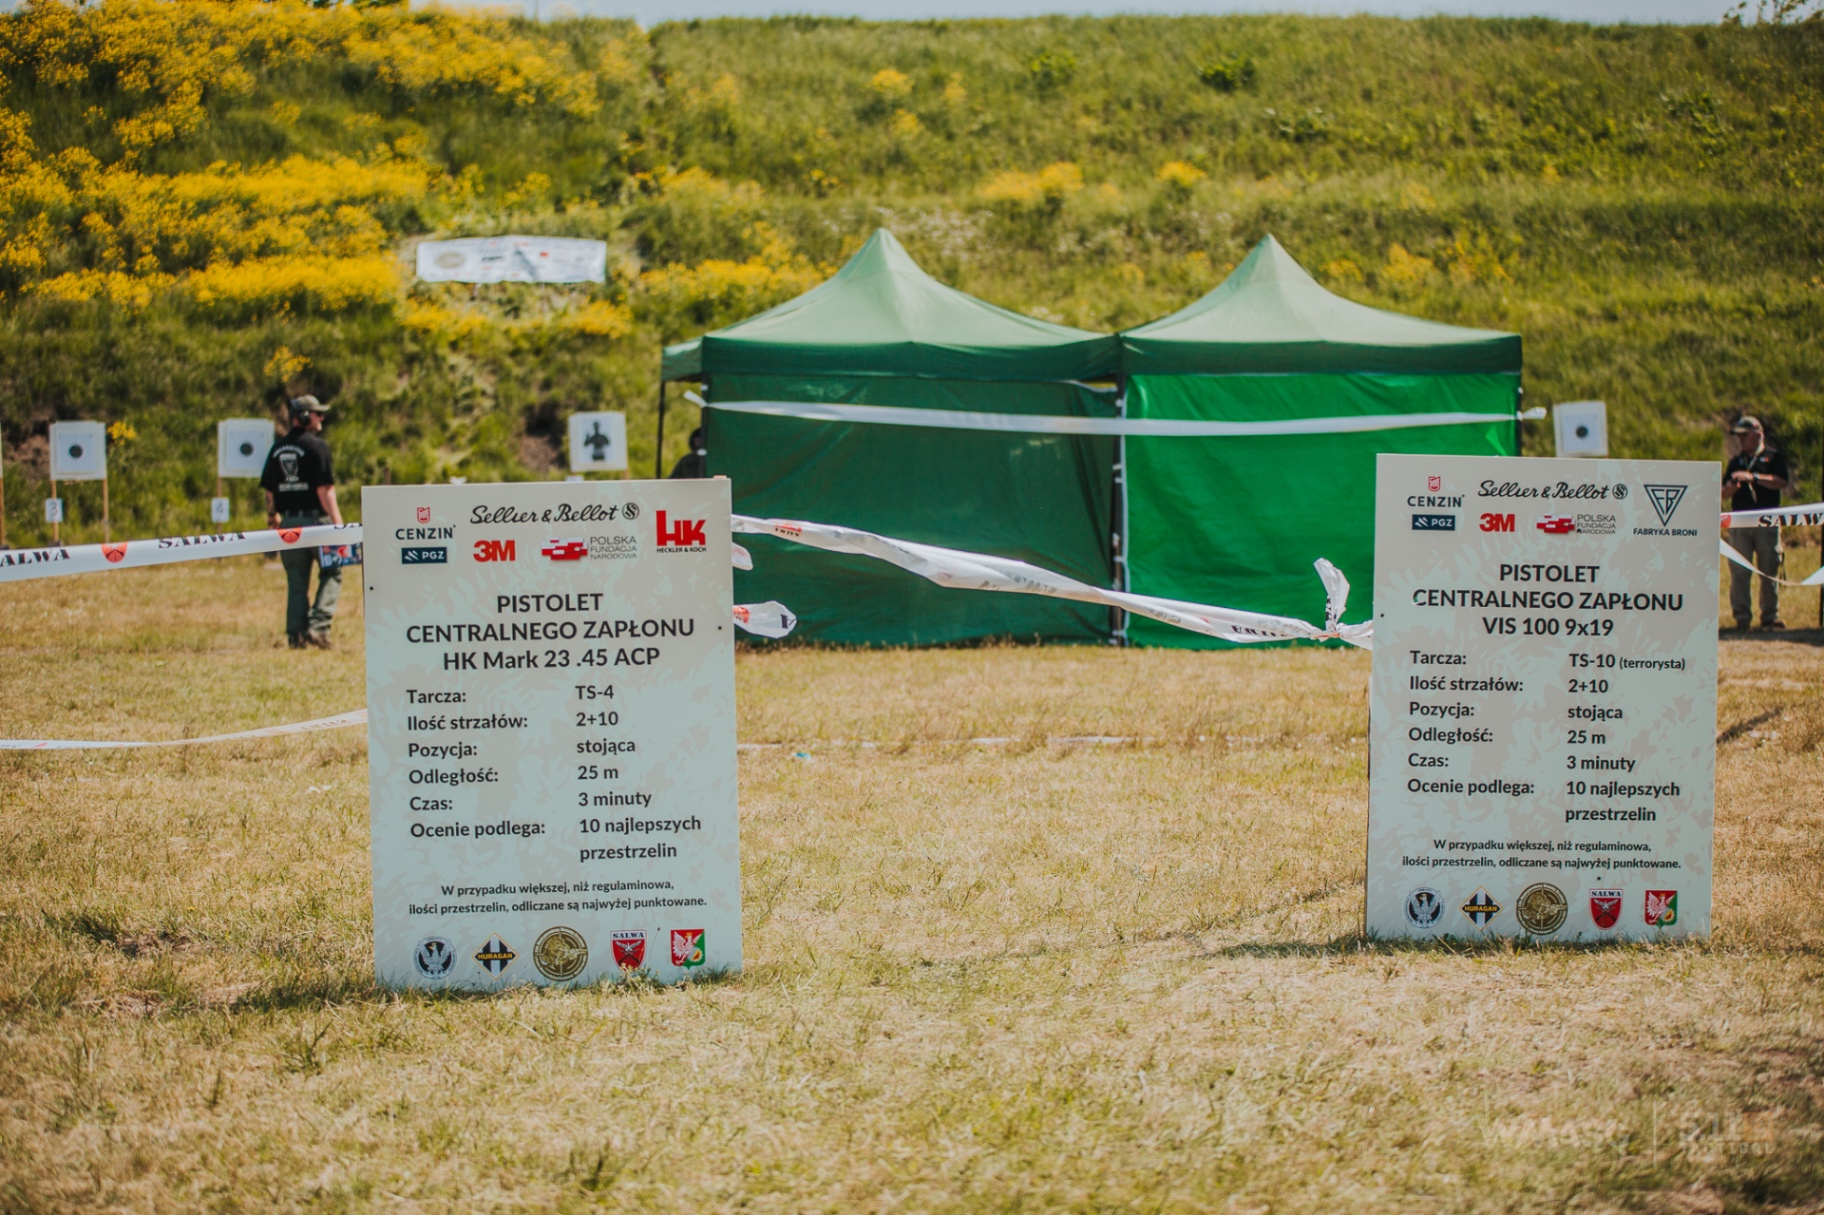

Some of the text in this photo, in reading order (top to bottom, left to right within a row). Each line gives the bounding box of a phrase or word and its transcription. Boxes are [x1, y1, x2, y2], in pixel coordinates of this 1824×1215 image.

[1478, 480, 1538, 497] Sellier
[1541, 486, 1550, 498] &
[1552, 482, 1609, 499] Bellot
[470, 505, 537, 524] Sellier
[541, 507, 550, 523] &
[554, 504, 618, 521] Bellot
[656, 510, 706, 546] HK
[1432, 518, 1453, 527] PGZ
[1479, 513, 1515, 532] 3M
[590, 536, 637, 545] POLSKA
[1633, 528, 1697, 537] FABRYKA BRONI
[158, 533, 246, 549] SALWA
[422, 551, 444, 560] PGZ
[474, 540, 516, 562] 3M
[1500, 564, 1600, 582] PISTOLET
[498, 594, 603, 613] PISTOLET
[1413, 589, 1682, 611] CENTRALNEGO ZAPŁONU
[407, 619, 693, 643] CENTRALNEGO ZAPŁONU
[1483, 617, 1613, 636] VIS 100 9x19
[444, 648, 659, 670] HK Mark 23 .45 ACP
[1410, 651, 1466, 664] Tarcza:
[1569, 654, 1685, 670] TS-10 (terrorysta)
[1411, 676, 1523, 691] Ilość strzałów:
[1569, 679, 1608, 693] 2+10
[407, 690, 465, 703] Tarcza:
[575, 685, 613, 699] TS-4
[1410, 702, 1474, 719] Pozycja:
[1568, 705, 1622, 721] stojąca
[408, 714, 527, 730] Ilość strzałów:
[577, 712, 618, 726] 2+10
[1409, 728, 1492, 744] Odległość:
[1568, 730, 1605, 744] 25 m
[409, 742, 477, 759] Pozycja:
[577, 738, 635, 755] stojąca
[1409, 753, 1448, 767] Czas:
[1567, 756, 1635, 772] 3 minuty
[409, 768, 498, 786] Odległość:
[578, 766, 618, 779] 25 m
[1408, 779, 1534, 796] Ocenie podlega:
[1567, 781, 1679, 798] 10 najlepszych
[410, 797, 452, 810] Czas:
[579, 792, 651, 807] 3 minuty
[1566, 807, 1655, 823] przestrzelin
[411, 821, 544, 838] Ocenie podlega:
[580, 816, 700, 835] 10 najlepszych
[581, 843, 676, 862] przestrzelin
[1434, 840, 1651, 852] W przypadku większej, niż regulaminowa,
[1403, 856, 1680, 869] ilości przestrzelin, odliczane są najwyżej punktowane.
[442, 880, 675, 898] W przypadku większej, niż regulaminowa,
[1591, 890, 1622, 898] SALWA
[409, 897, 706, 915] ilości przestrzelin, odliczane są najwyżej punktowane.
[612, 932, 645, 940] SALWA
[477, 952, 514, 960] HURAGAN
